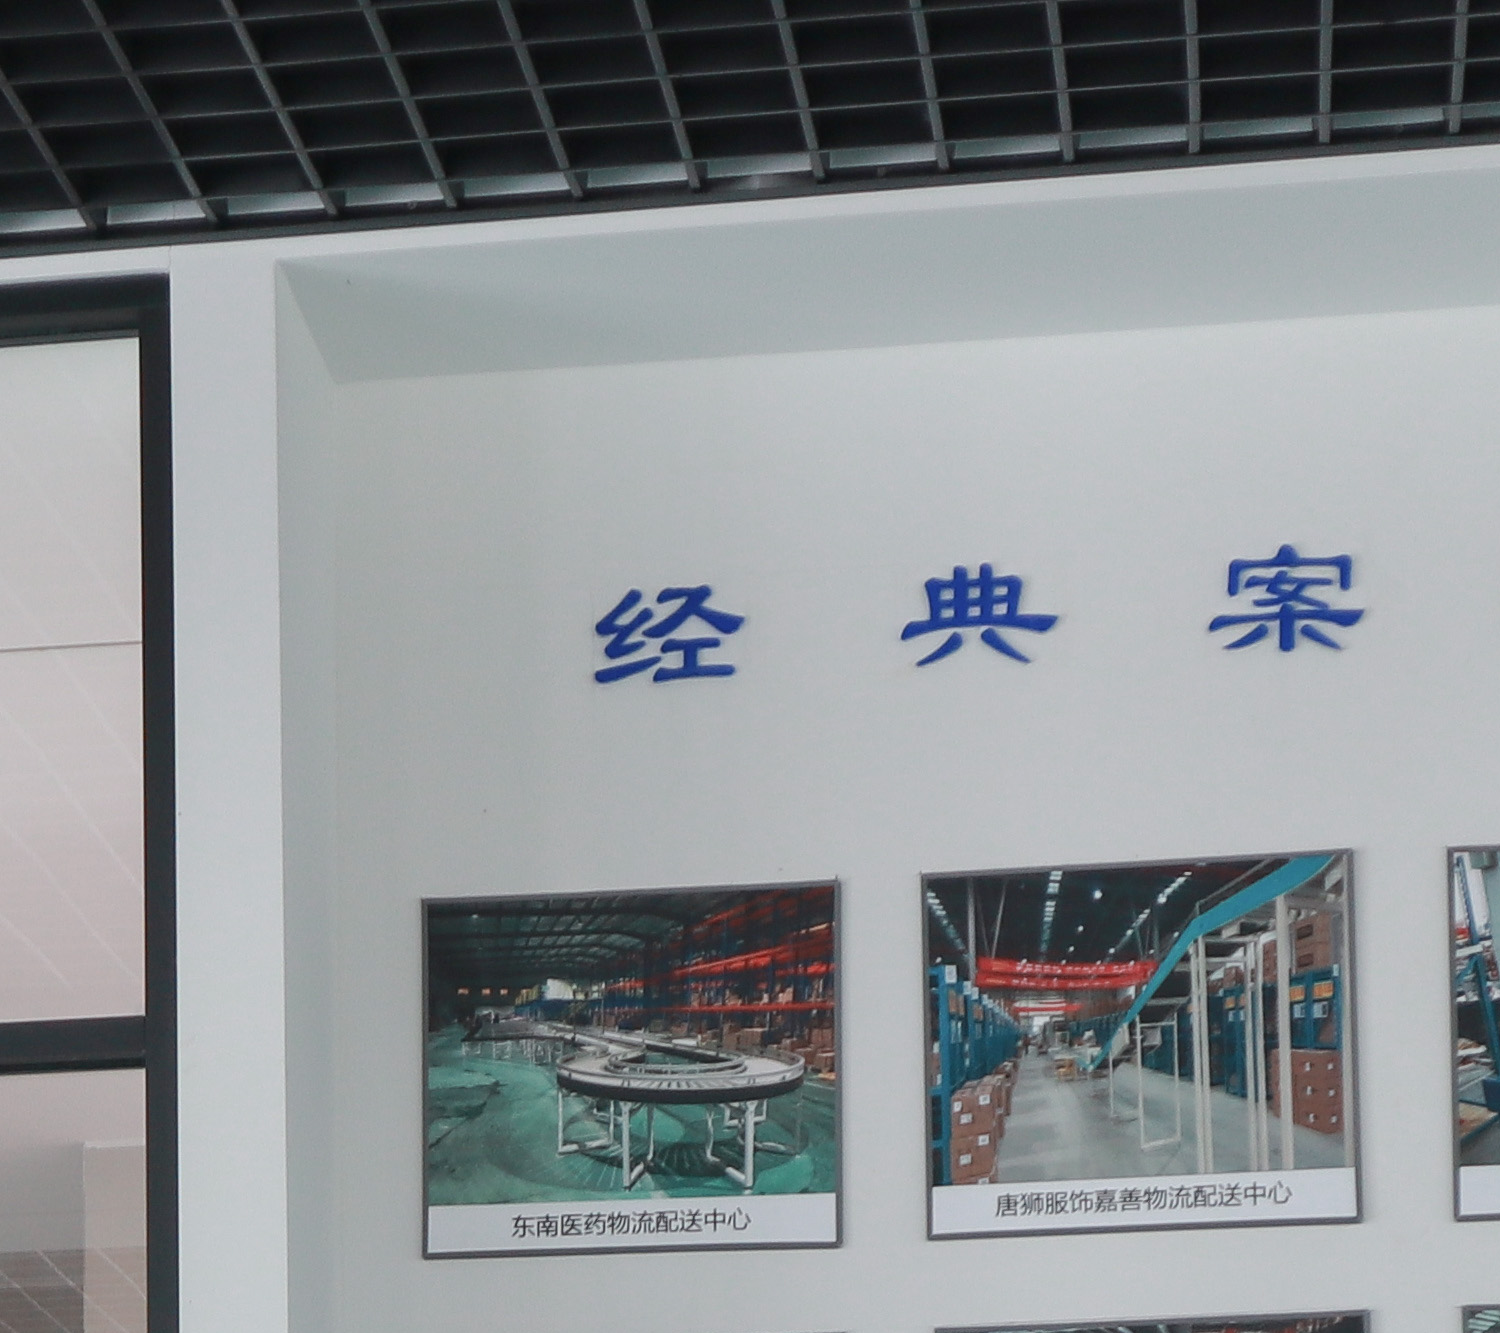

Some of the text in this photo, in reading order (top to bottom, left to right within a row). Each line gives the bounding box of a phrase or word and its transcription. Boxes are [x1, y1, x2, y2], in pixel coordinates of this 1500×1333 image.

[993, 1180, 1293, 1218] 唐狮服饰嘉善物流配送中心
[510, 1208, 752, 1239] 东南医药物流配送中心
